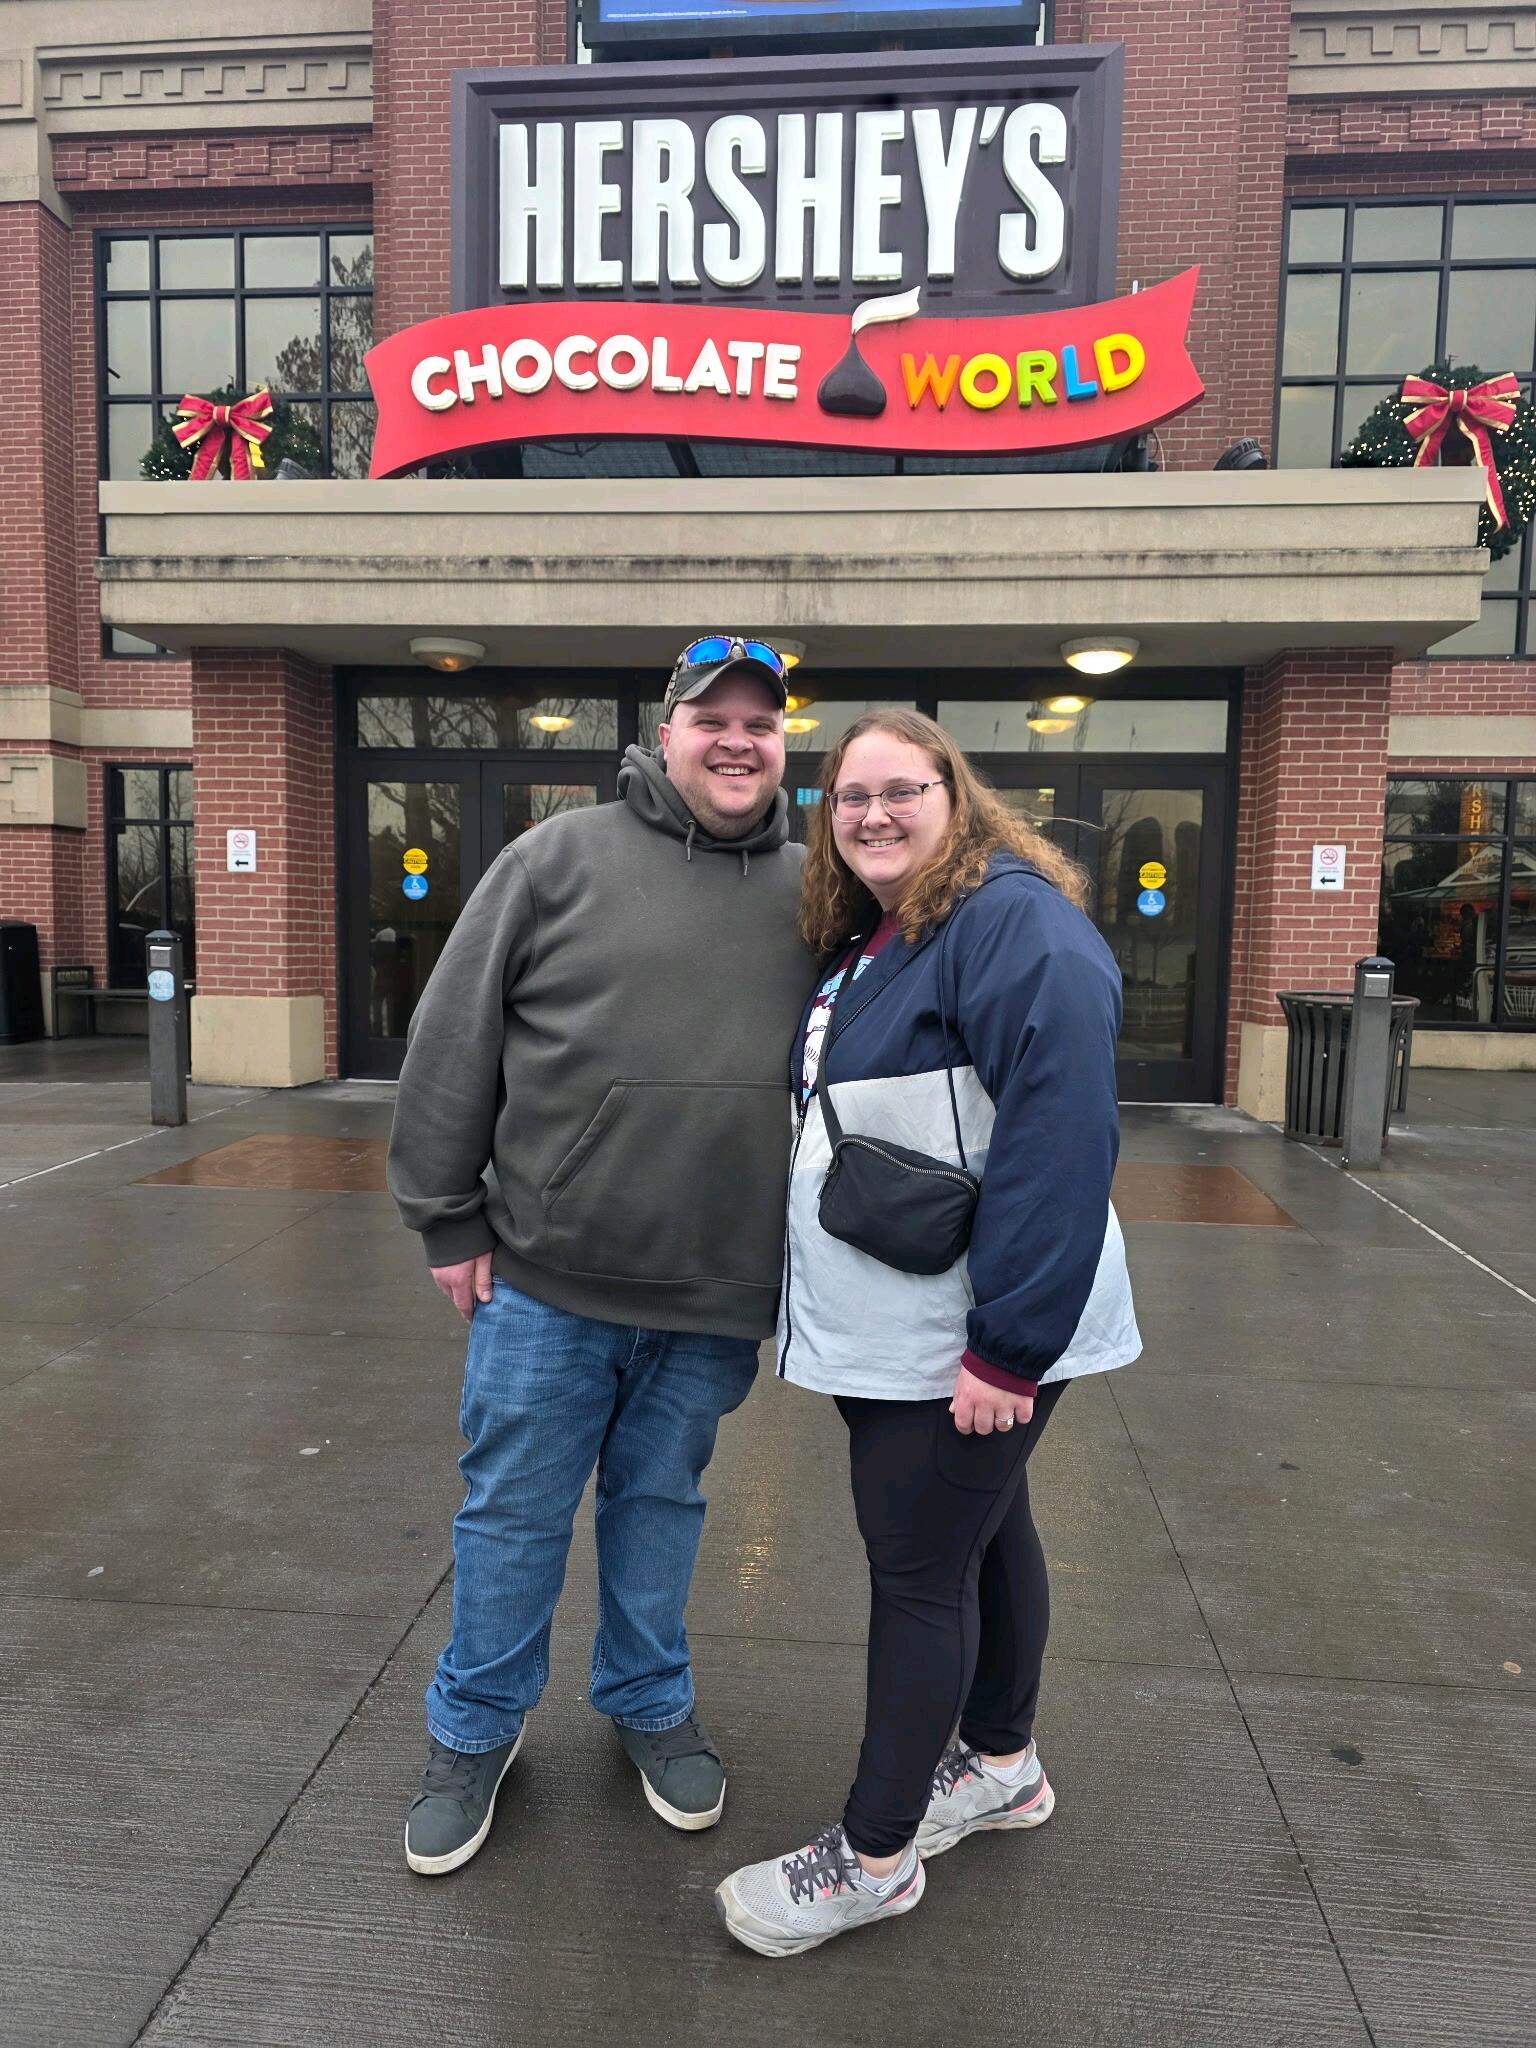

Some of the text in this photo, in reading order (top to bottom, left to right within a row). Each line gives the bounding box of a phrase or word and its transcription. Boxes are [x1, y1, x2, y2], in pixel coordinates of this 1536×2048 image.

[499, 102, 1067, 288] HERSHEY'S
[411, 332, 1146, 411] CHOCOLATE WORLD
